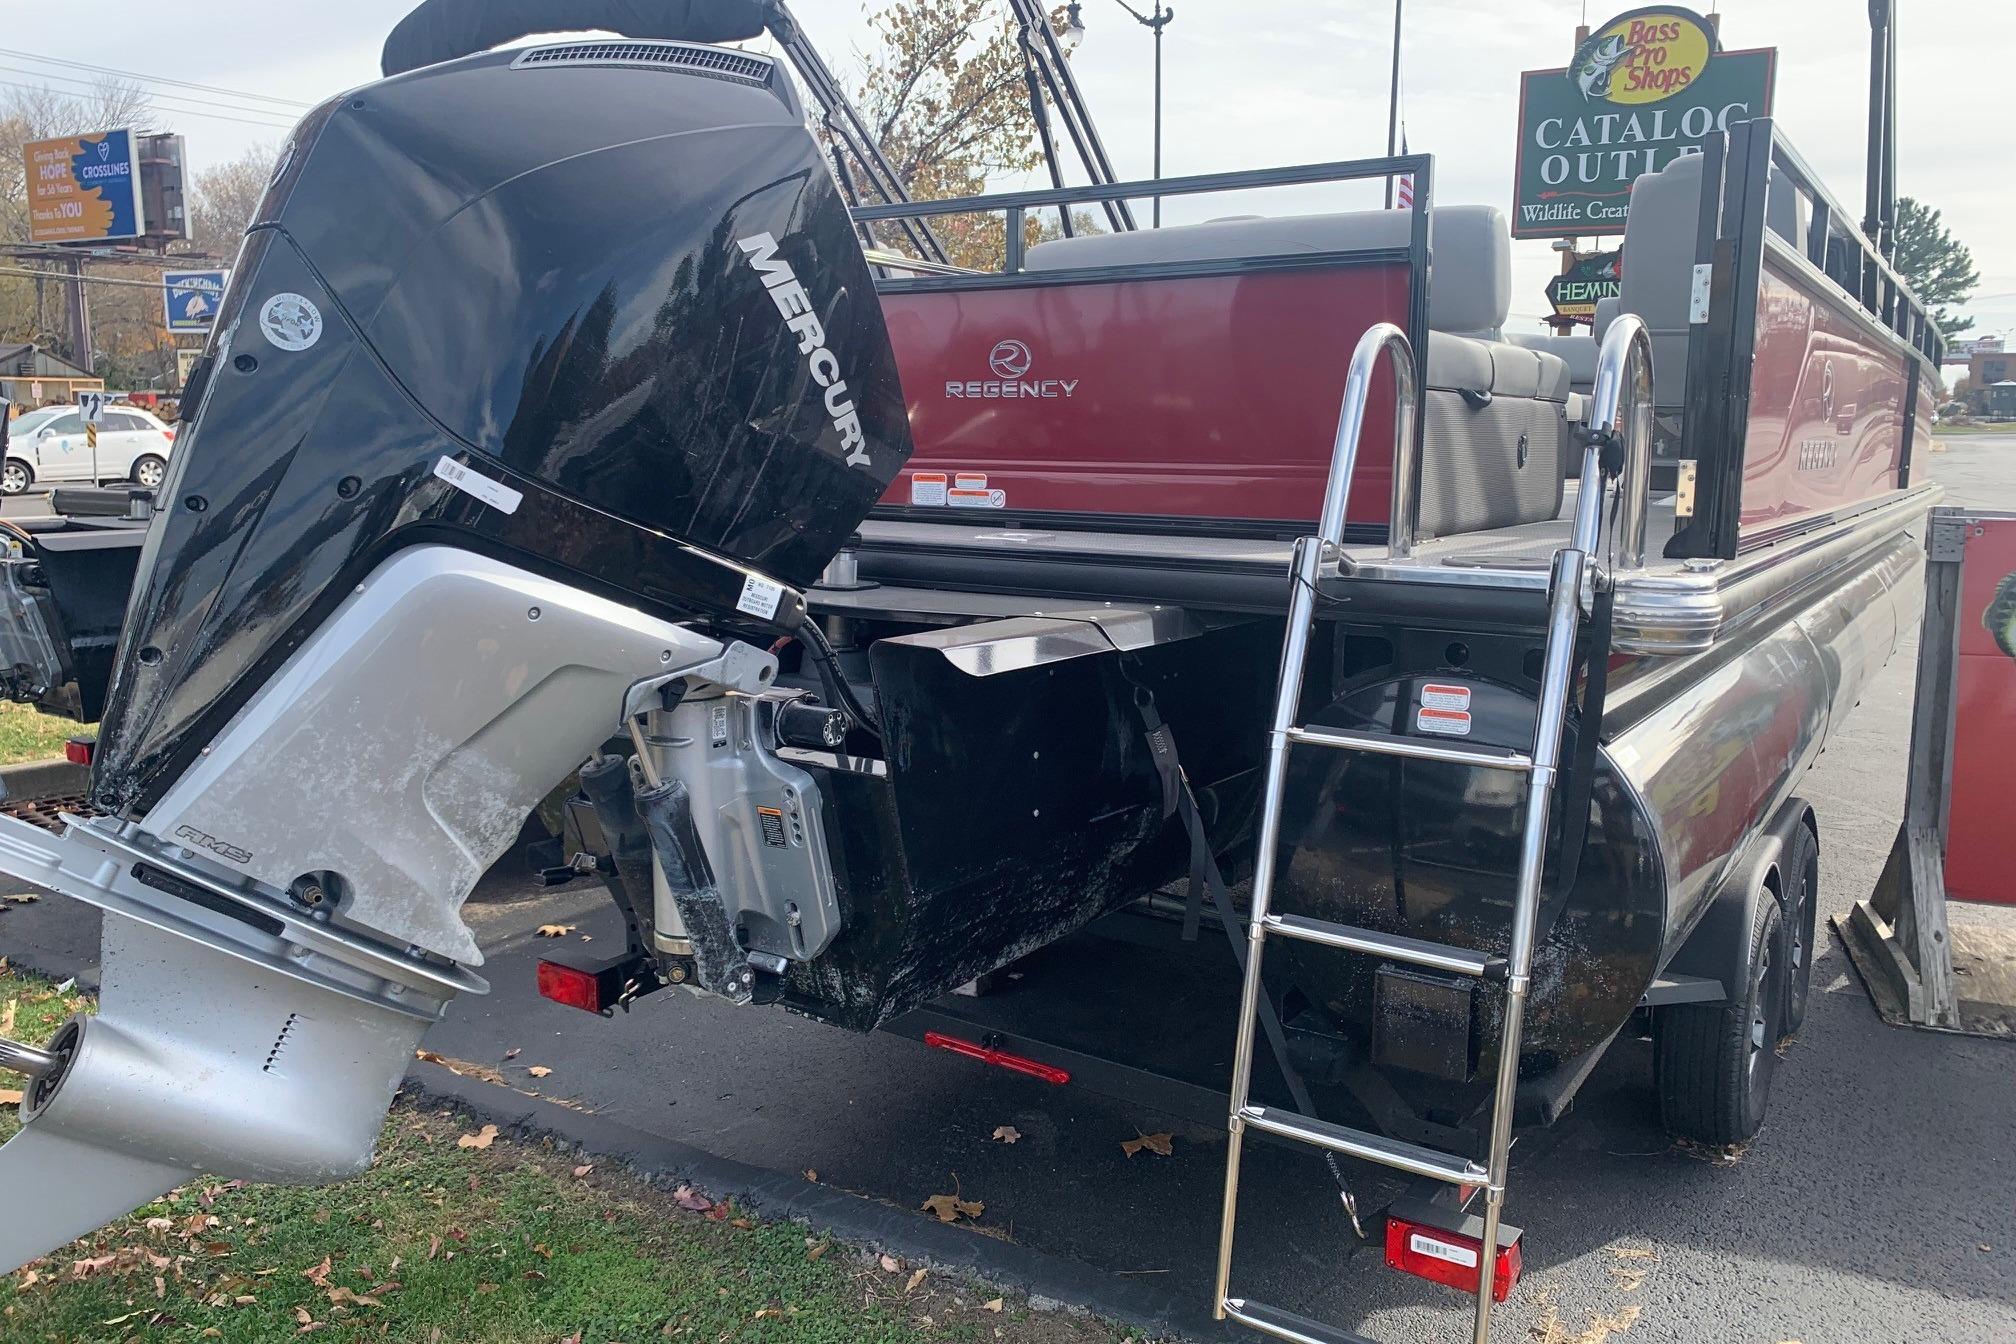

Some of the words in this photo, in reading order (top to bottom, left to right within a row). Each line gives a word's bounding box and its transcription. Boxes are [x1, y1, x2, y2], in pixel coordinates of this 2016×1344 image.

[1626, 20, 1680, 45] Bass
[1624, 44, 1667, 68] Pro
[1624, 66, 1691, 93] Shops
[40, 162, 67, 180] HOPE
[82, 161, 130, 179] CROSSLINES
[1540, 145, 1702, 185] OUTL
[60, 201, 82, 218] YOU
[1521, 203, 1581, 222] Wildlife
[1586, 201, 1630, 219] Creat
[1557, 281, 1622, 302] HEMIN
[1562, 305, 1592, 313] BANQUET
[737, 231, 871, 467] MERCURY
[945, 379, 1079, 399] REGENCY
[175, 824, 253, 864] AMS
